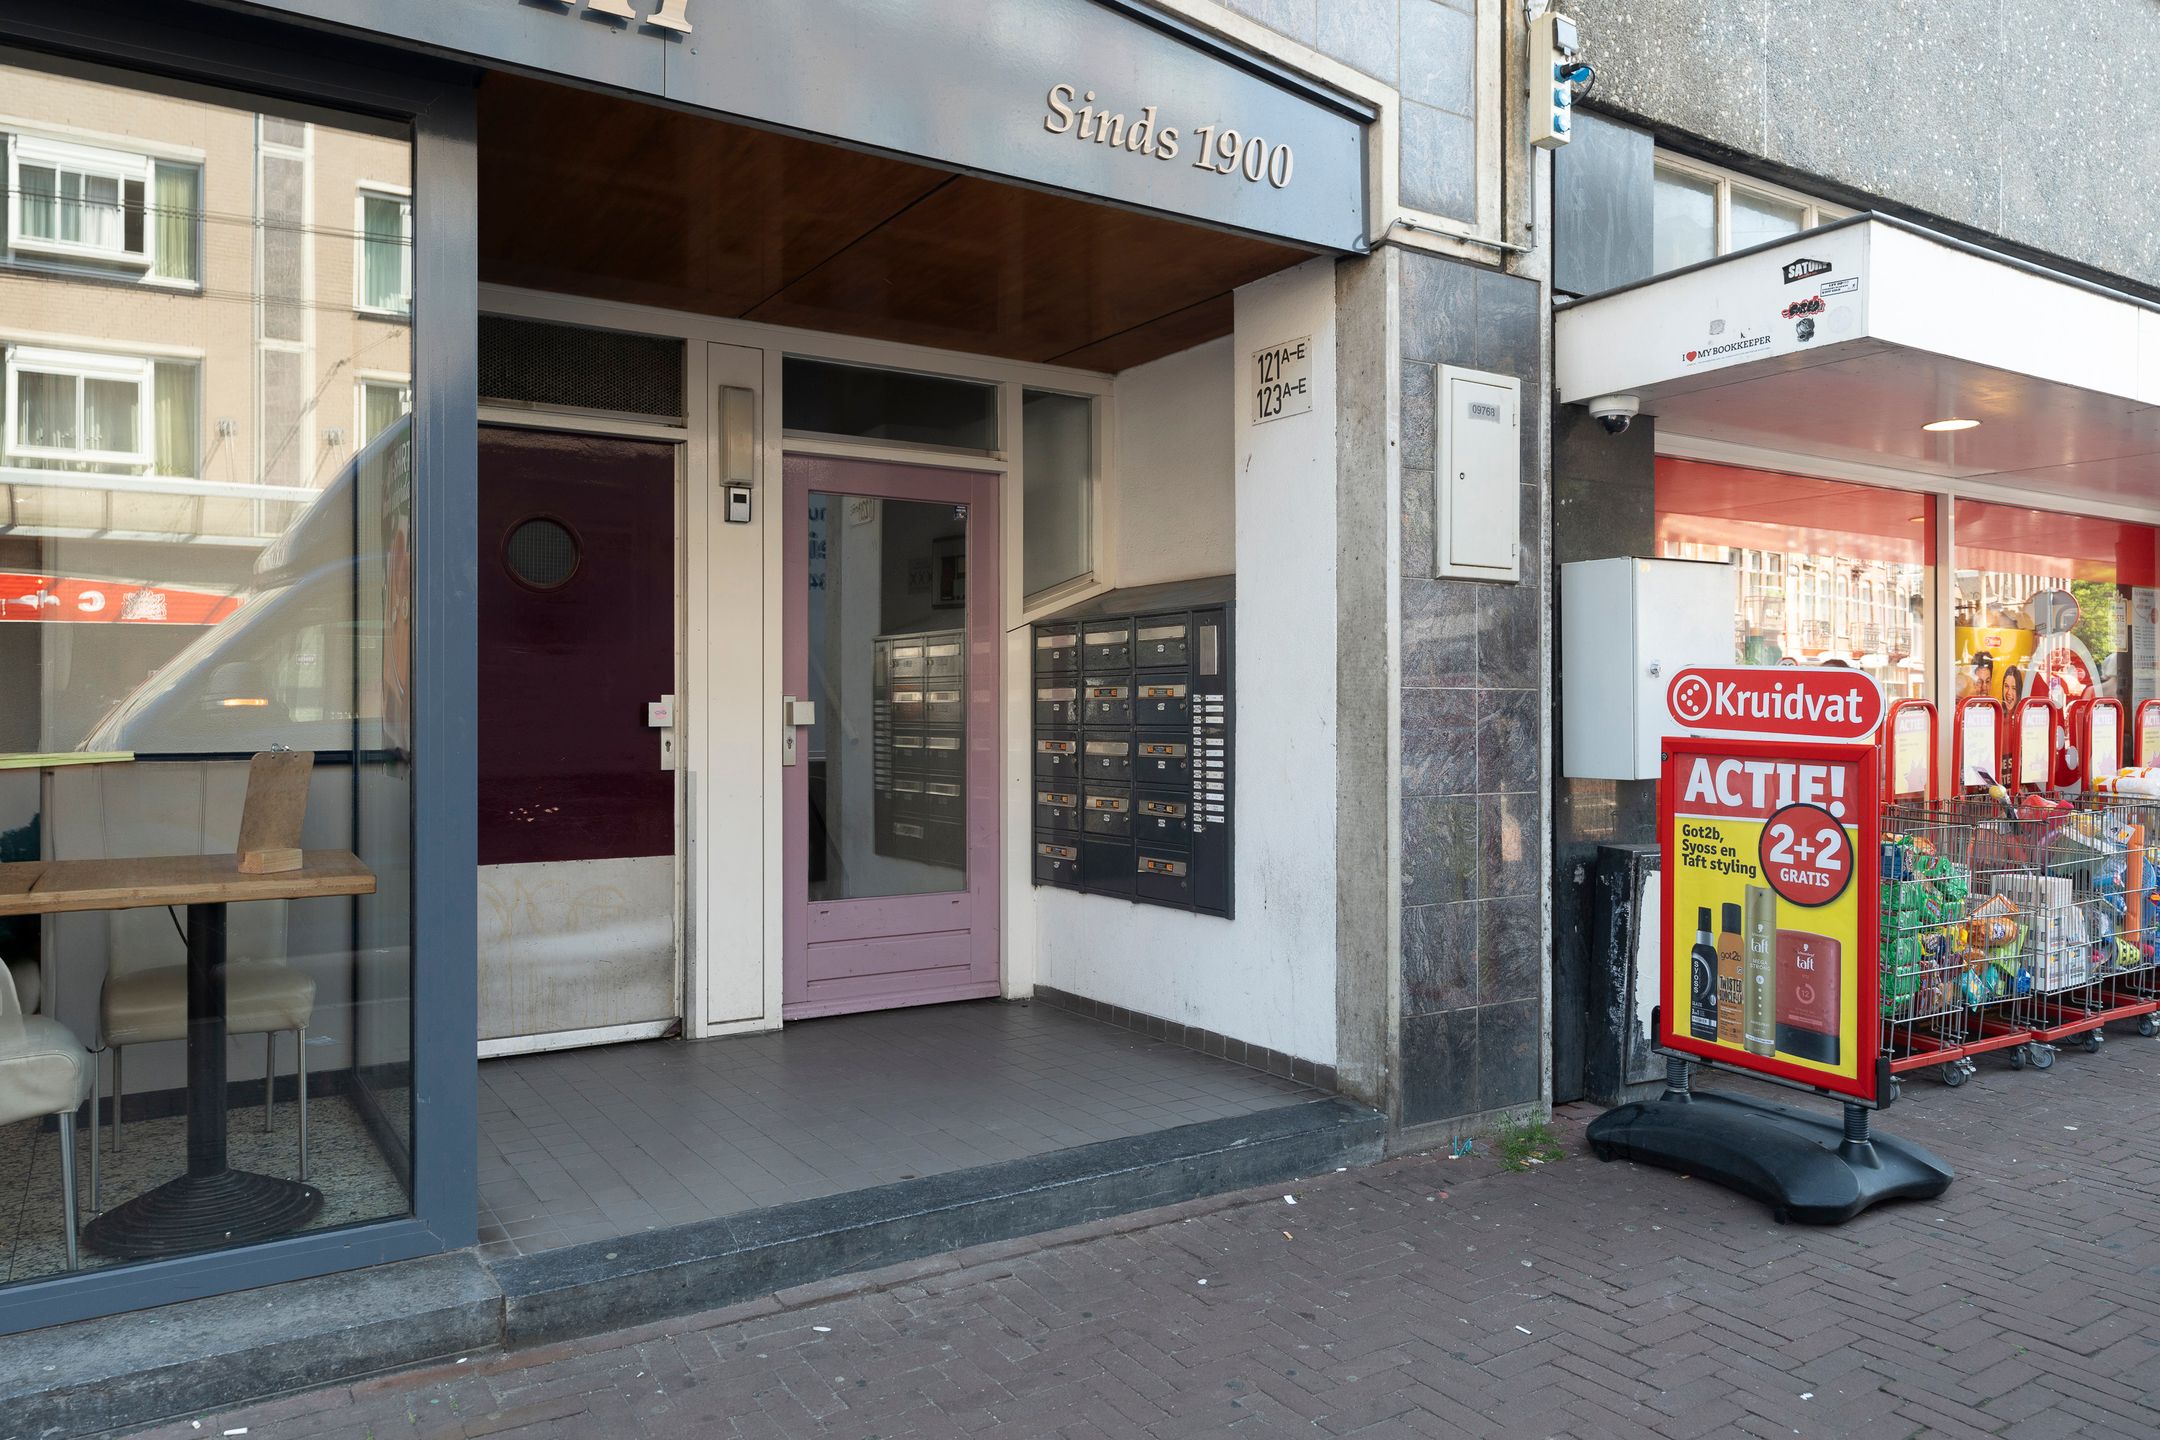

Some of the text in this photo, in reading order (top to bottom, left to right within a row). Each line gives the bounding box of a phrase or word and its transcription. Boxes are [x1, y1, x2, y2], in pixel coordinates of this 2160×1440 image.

[1044, 83, 1294, 188] Sinds 1900
[1697, 349, 1712, 359] MY
[1712, 335, 1772, 355] BOOKKEEPER
[1472, 404, 1496, 418] 09768
[1715, 682, 1864, 724] Kruidvat
[1684, 757, 1846, 818] ACTIE!
[1682, 824, 1724, 843] Got2b,
[1682, 839, 1737, 858] Syoss en
[1769, 823, 1842, 871] 2+2
[1682, 854, 1757, 879] Taft styling
[1780, 868, 1830, 887] GRATIS
[1751, 938, 1769, 954] taft
[1720, 951, 1742, 962] got2b
[1796, 955, 1815, 971] taft
